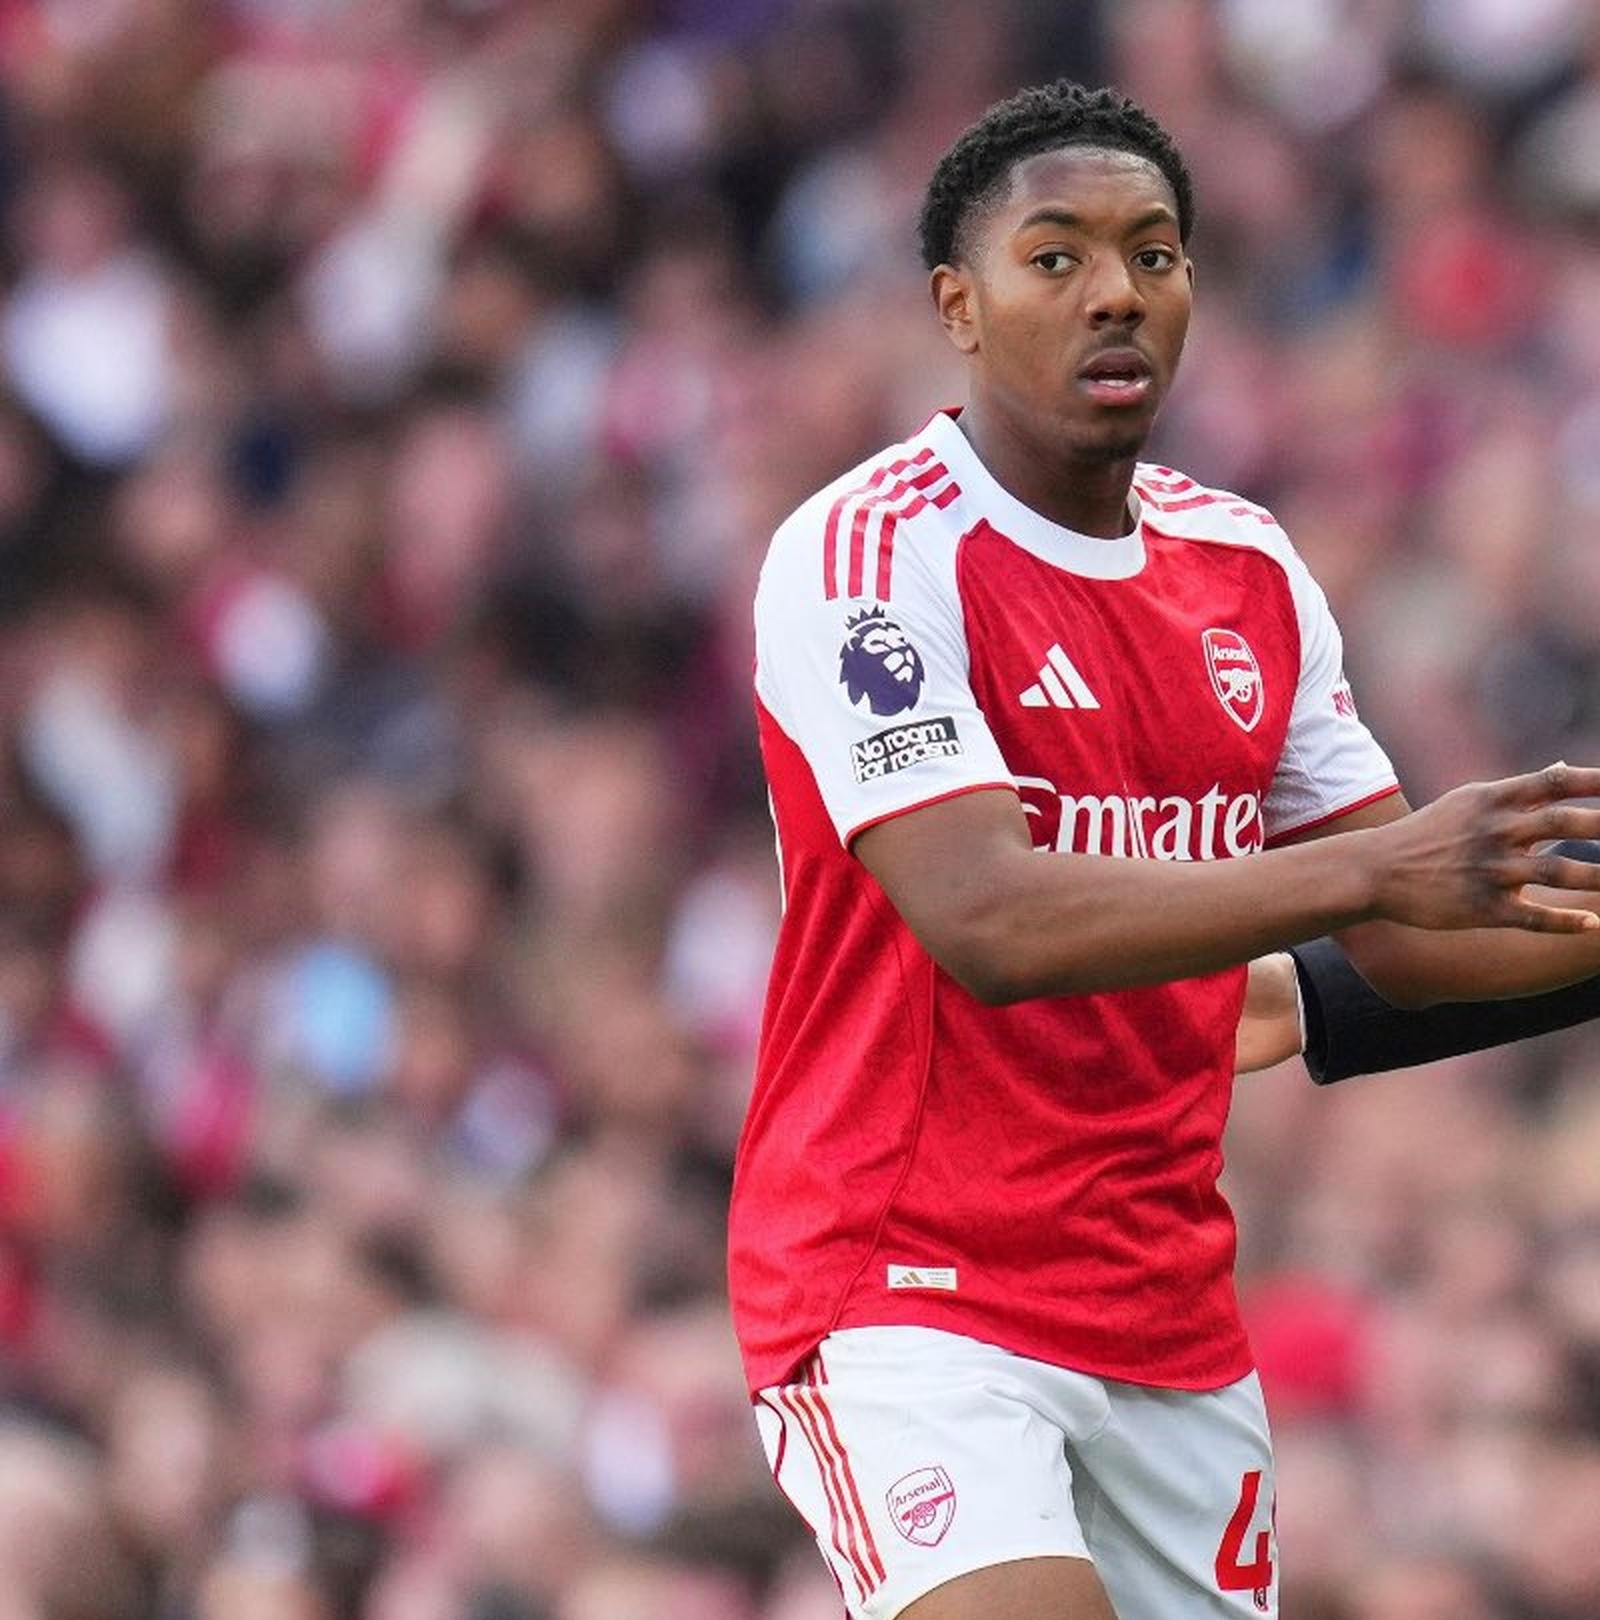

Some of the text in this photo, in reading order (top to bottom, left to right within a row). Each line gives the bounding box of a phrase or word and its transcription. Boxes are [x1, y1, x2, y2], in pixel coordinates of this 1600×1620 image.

[851, 723, 947, 765] No room
[895, 1477, 941, 1508] Arsenal
